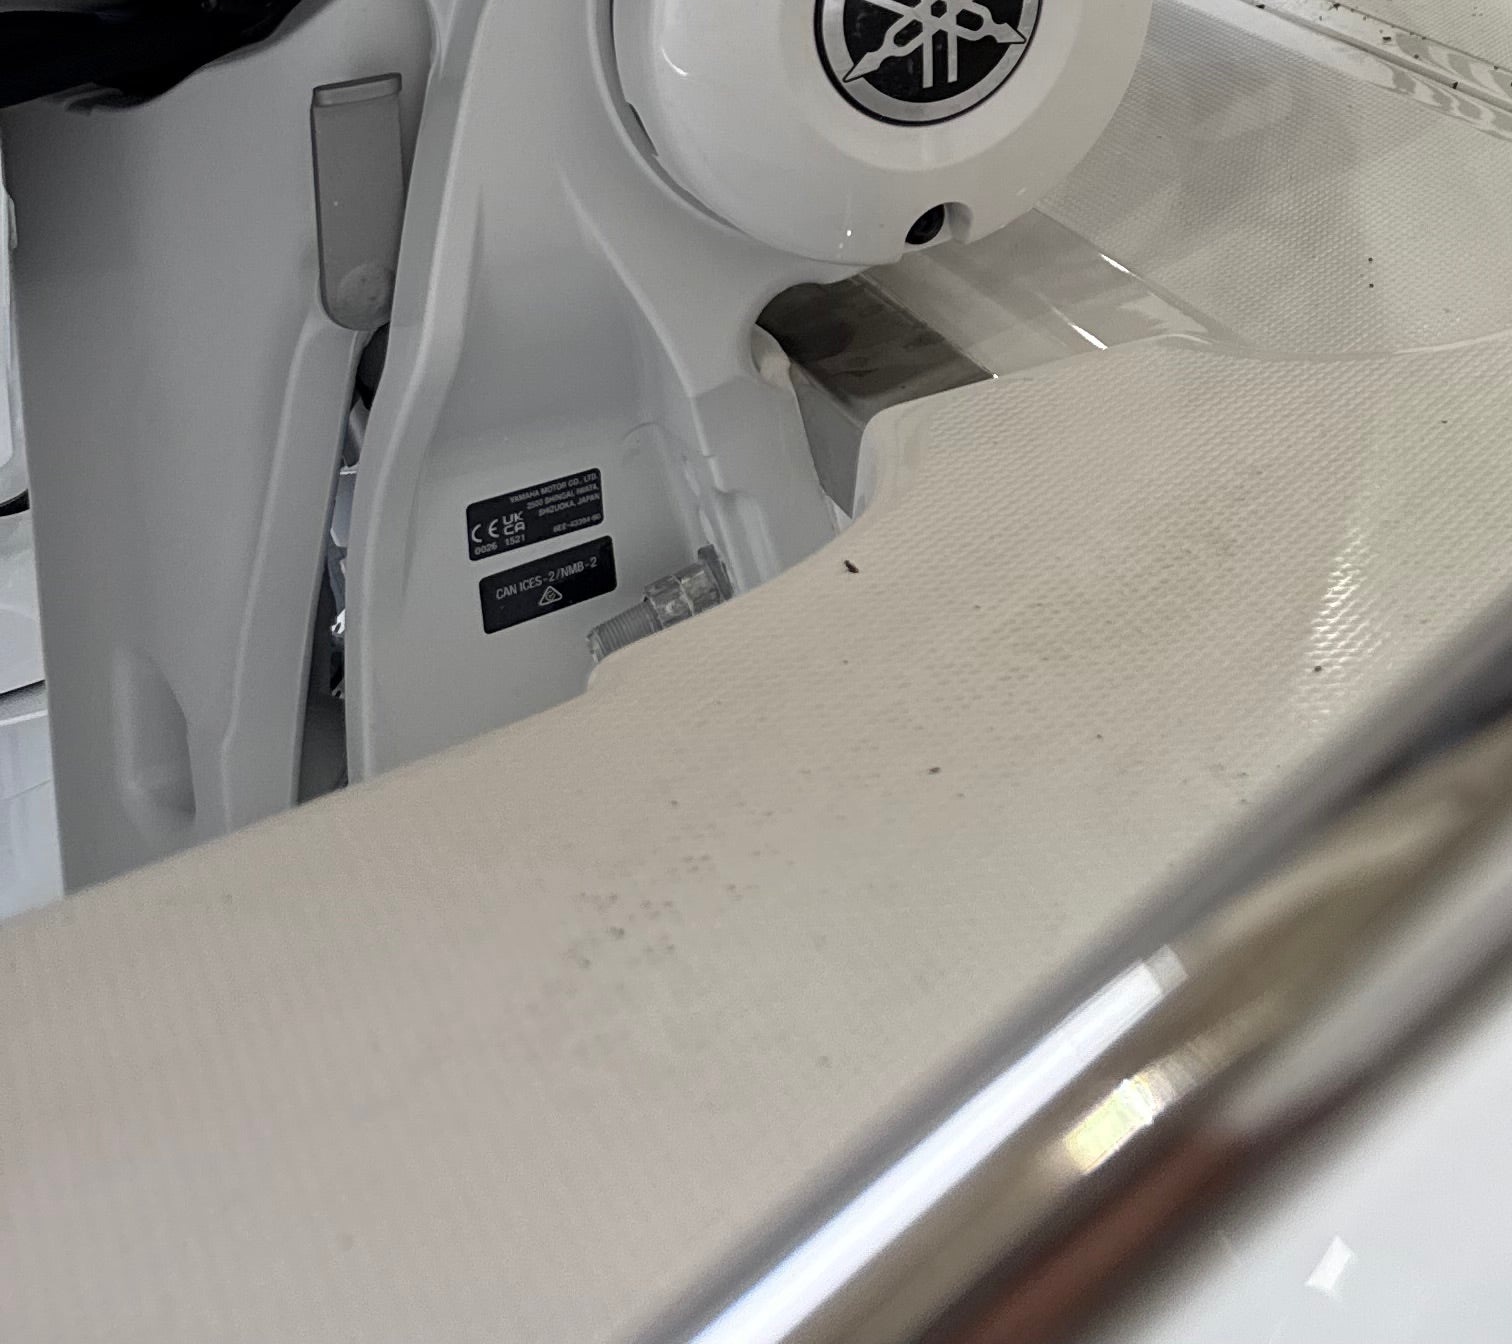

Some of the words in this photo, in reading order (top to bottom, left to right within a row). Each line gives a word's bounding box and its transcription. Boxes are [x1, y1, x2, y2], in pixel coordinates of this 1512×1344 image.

[510, 491, 540, 503] YAMAHA
[541, 481, 566, 495] MOTOR
[502, 511, 524, 525] UK
[474, 542, 498, 555] 0026
[505, 534, 525, 545] 1521
[496, 583, 517, 600] CAN
[519, 556, 597, 592] ICES-2/NMB-2
